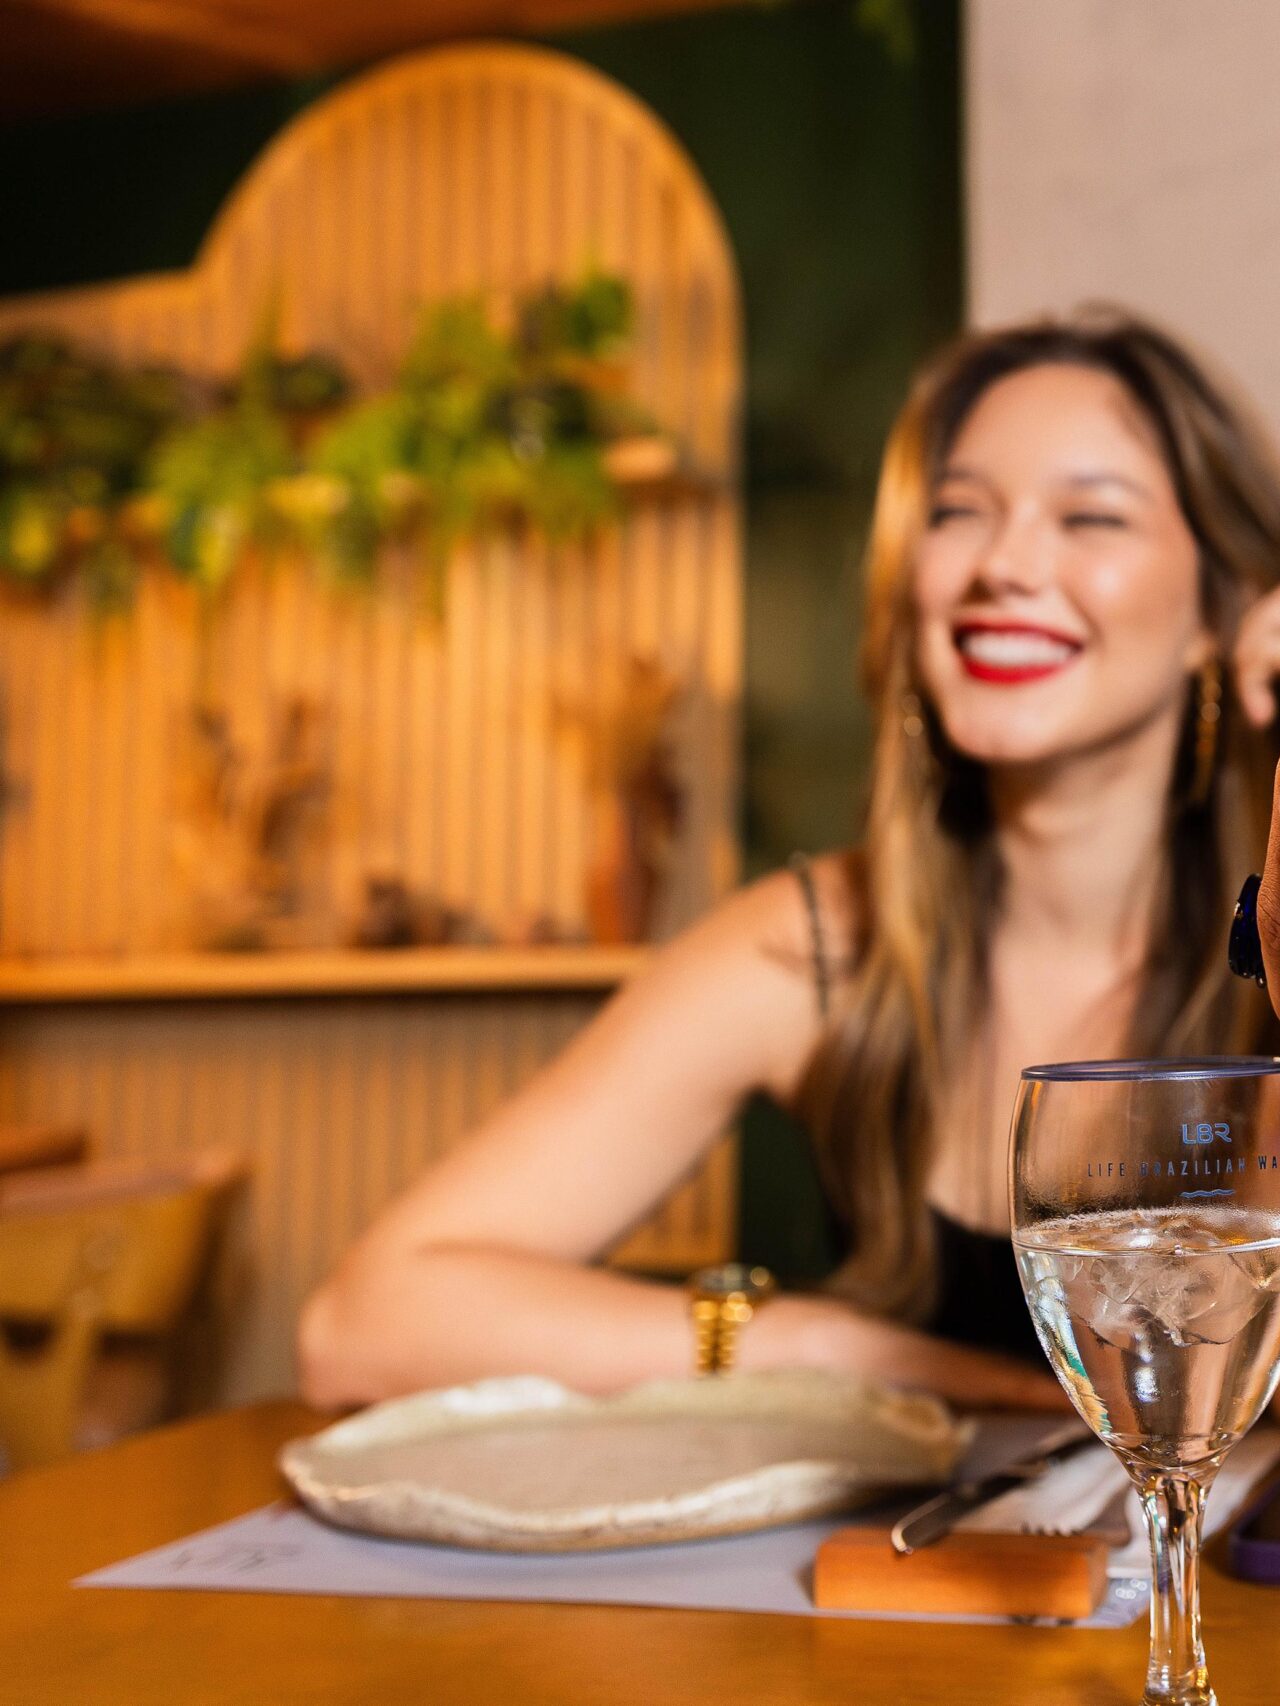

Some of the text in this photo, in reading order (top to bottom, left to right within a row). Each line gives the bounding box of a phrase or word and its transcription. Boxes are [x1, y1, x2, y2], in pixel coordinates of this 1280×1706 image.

[1182, 1123, 1232, 1144] LBR
[1087, 1162, 1125, 1177] LIFE
[1140, 1157, 1246, 1177] BRAZILIAN
